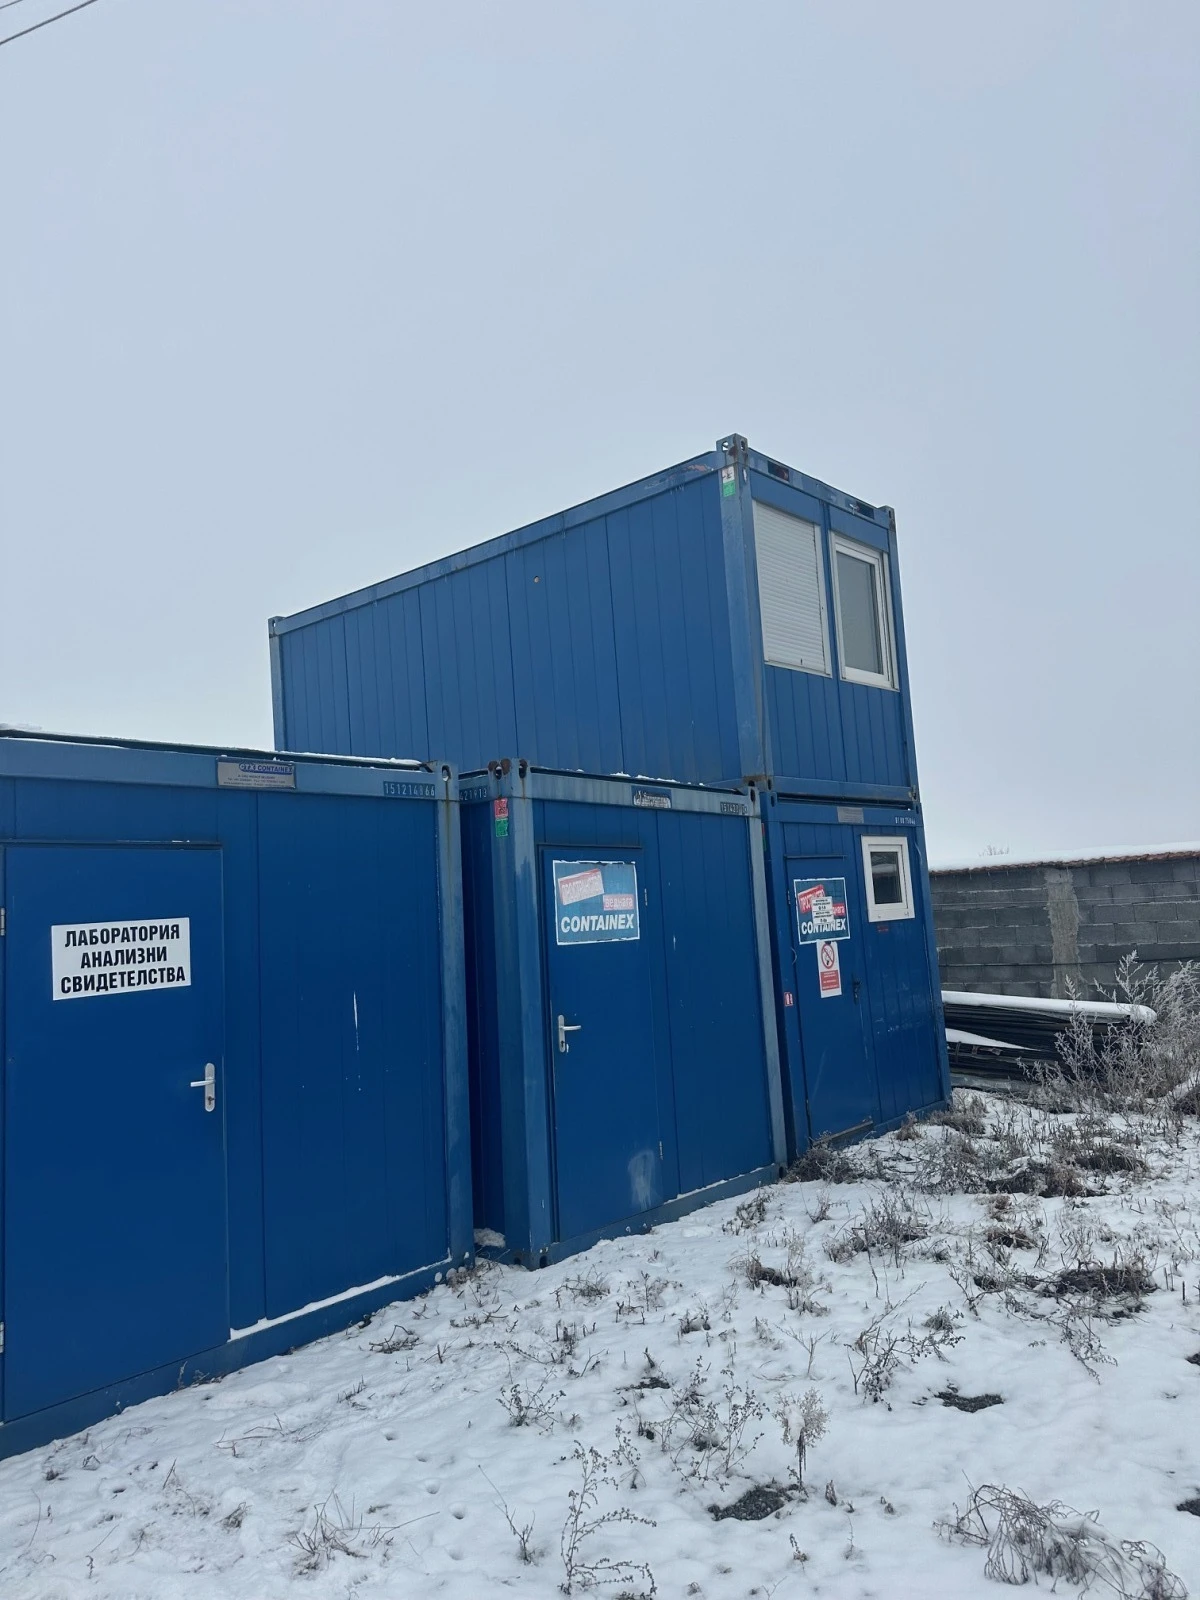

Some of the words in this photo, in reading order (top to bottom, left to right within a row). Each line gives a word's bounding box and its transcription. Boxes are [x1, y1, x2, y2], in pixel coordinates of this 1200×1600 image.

[257, 764, 293, 773] CONTAINEX
[560, 914, 635, 933] CONTAINEX
[801, 918, 847, 935] CONTAINEX
[65, 924, 180, 948] ЛАБОРАТОРИЯ
[80, 946, 168, 969] АНАЛИЗНИ
[60, 966, 186, 994] СВИДЕТЕЛСТВА
